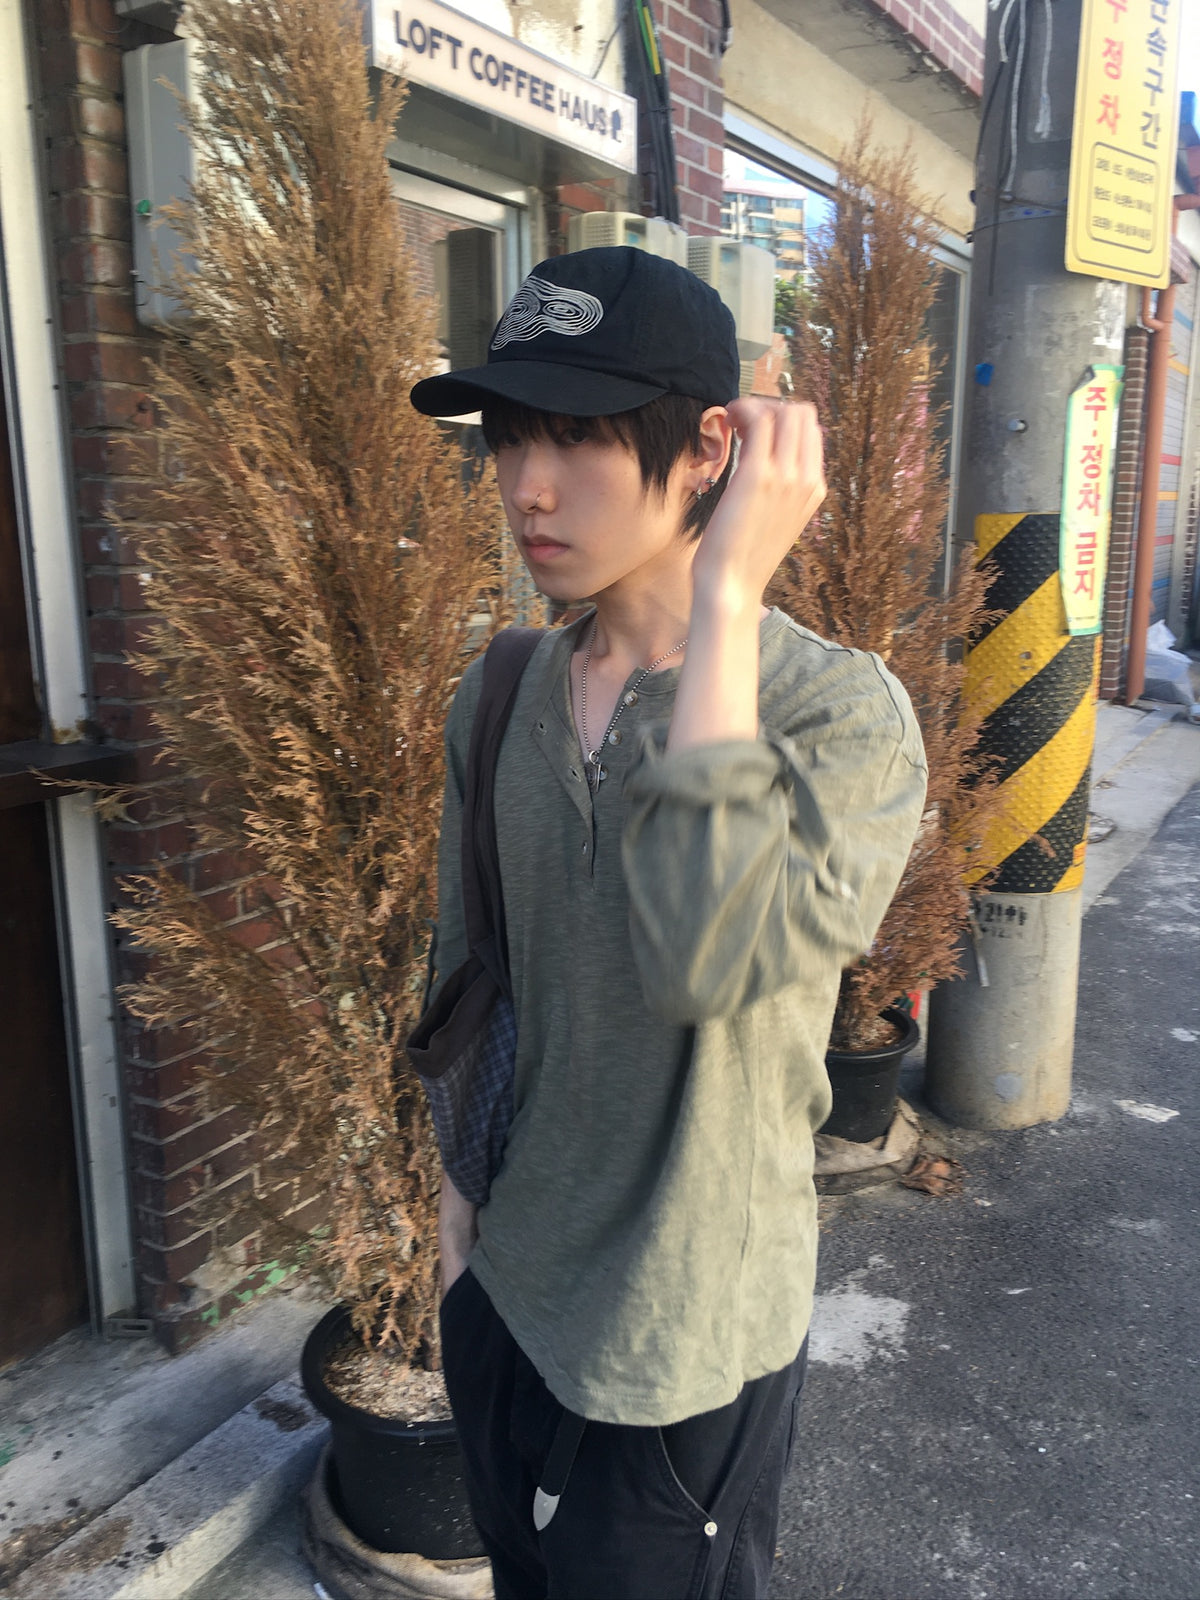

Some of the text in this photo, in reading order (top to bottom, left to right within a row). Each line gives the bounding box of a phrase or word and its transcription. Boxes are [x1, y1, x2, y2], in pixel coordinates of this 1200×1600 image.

[394, 10, 607, 136] LOFT COFFEE HAUS
[1073, 532, 1098, 600] 금지
